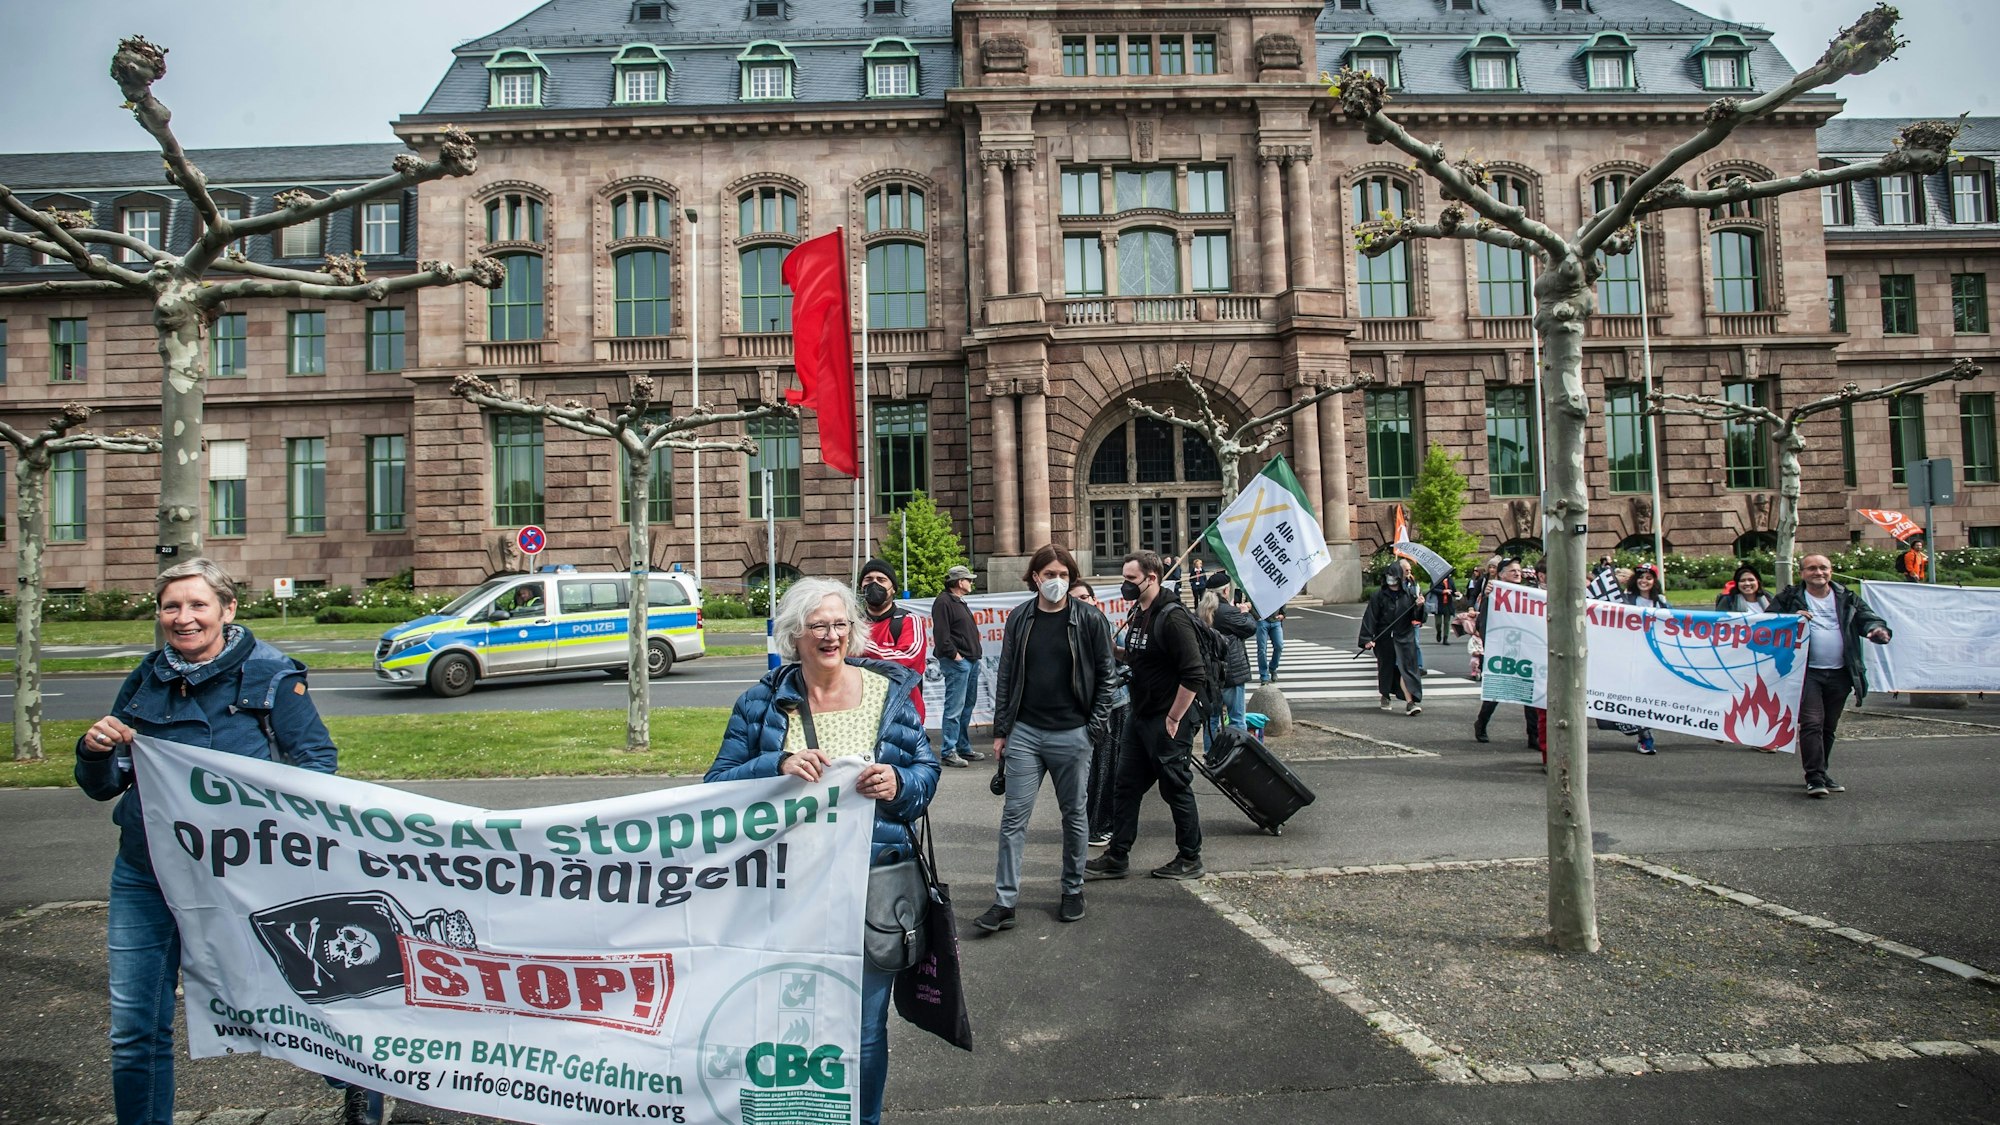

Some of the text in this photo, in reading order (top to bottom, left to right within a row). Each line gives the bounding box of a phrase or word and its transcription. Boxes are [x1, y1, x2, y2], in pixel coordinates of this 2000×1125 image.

[1263, 532, 1292, 566] Dörfer
[1275, 521, 1295, 543] Alle
[1251, 545, 1289, 589] BLEIBEN!
[572, 622, 616, 634] POLIZEI
[1663, 613, 1805, 649] stoppen!
[1487, 655, 1533, 678] CBG
[1586, 700, 1719, 731] .CBGnetwork.de
[1635, 696, 1720, 717] BAYER-Gefahren
[190, 766, 840, 858] GLYPHOSAT stoppen!
[358, 843, 787, 908] entschädigen!
[416, 949, 655, 1019] STOP!
[209, 997, 684, 1095] Coordination gegen BAYER-Gefahren
[745, 1042, 845, 1089] CBG
[452, 1070, 686, 1124] info@CBGnetwork.org
